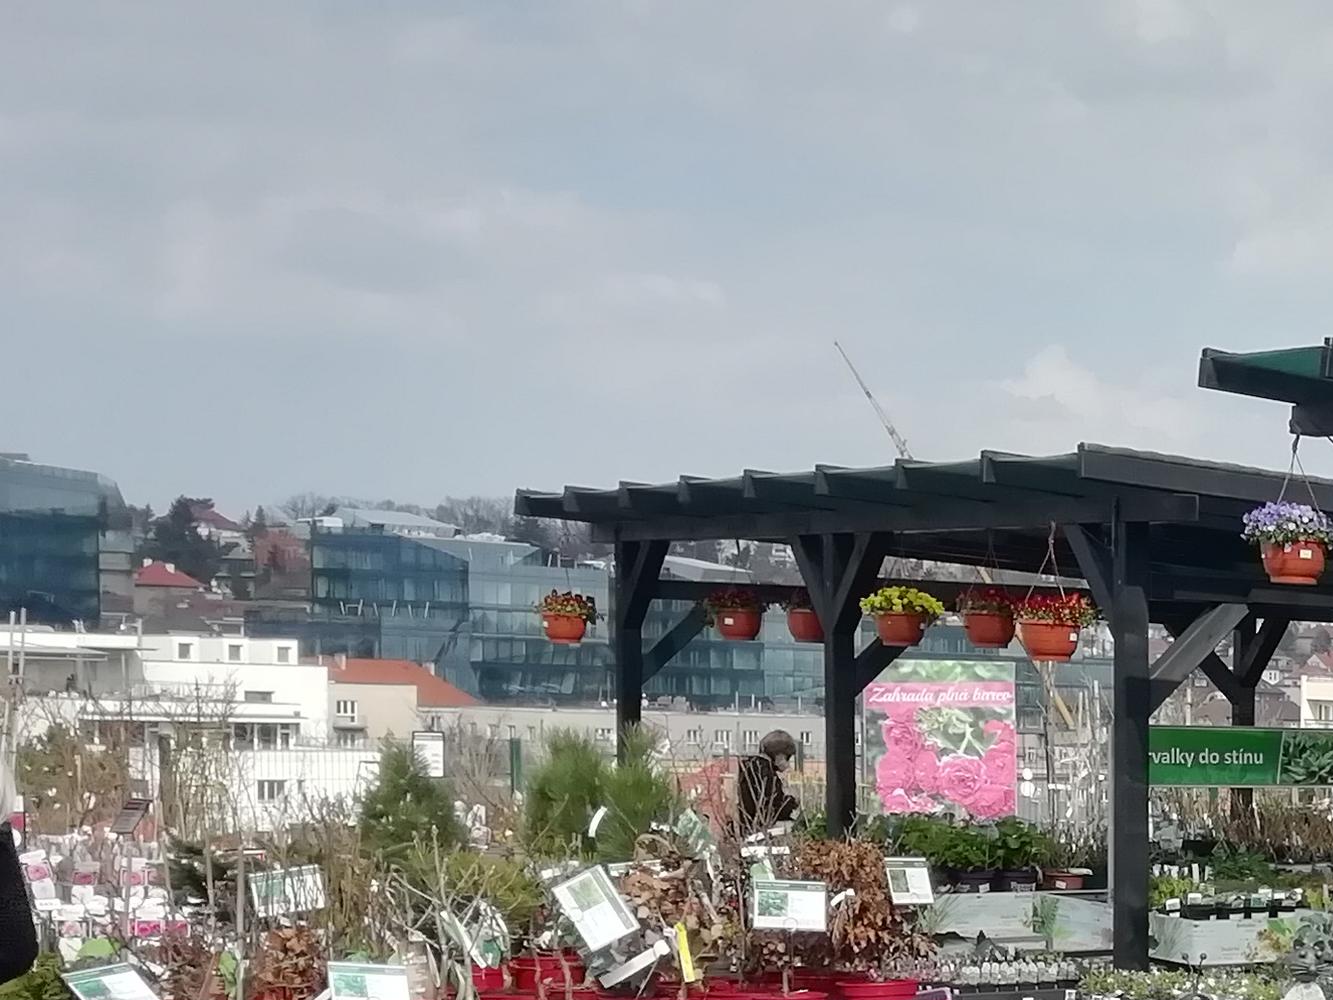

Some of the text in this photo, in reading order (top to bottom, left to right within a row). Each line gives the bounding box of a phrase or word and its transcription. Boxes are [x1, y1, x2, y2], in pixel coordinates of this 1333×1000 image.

[868, 687, 934, 703] Zahrada
[936, 687, 970, 705] plná
[1150, 747, 1264, 768] valky do stínu
